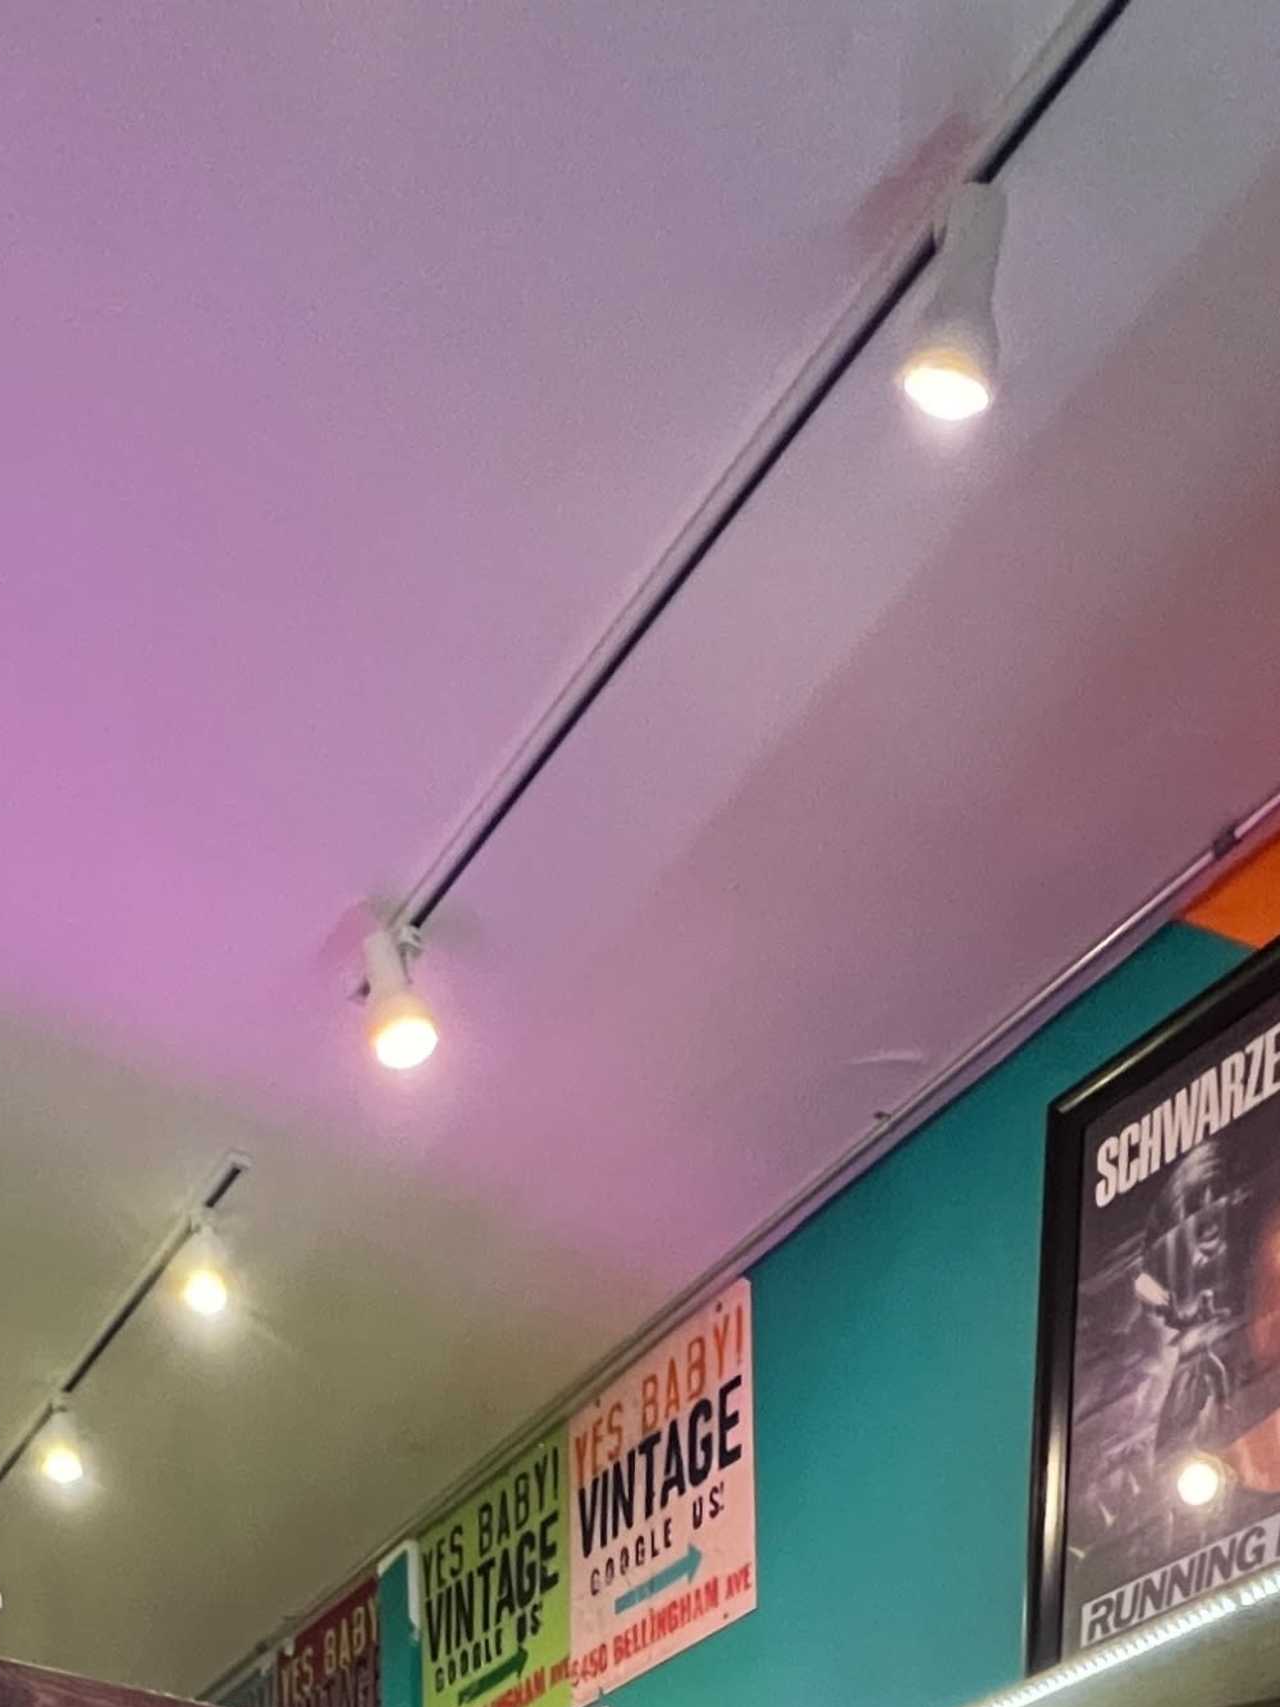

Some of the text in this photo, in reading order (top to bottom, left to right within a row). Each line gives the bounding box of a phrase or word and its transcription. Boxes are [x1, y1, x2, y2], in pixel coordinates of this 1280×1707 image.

[573, 1304, 746, 1482] YES BABY!
[422, 1446, 559, 1598] YES BABY!
[578, 1374, 743, 1558] VINTAGE
[425, 1510, 559, 1663] VINTAGE
[590, 1517, 673, 1596] GOOGLE
[613, 1576, 719, 1665] BELLINGHAM
[724, 1562, 752, 1600] AVE
[1088, 1526, 1265, 1645] RUNNING
[281, 1646, 314, 1707] YES
[435, 1627, 503, 1694] GOOGLE
